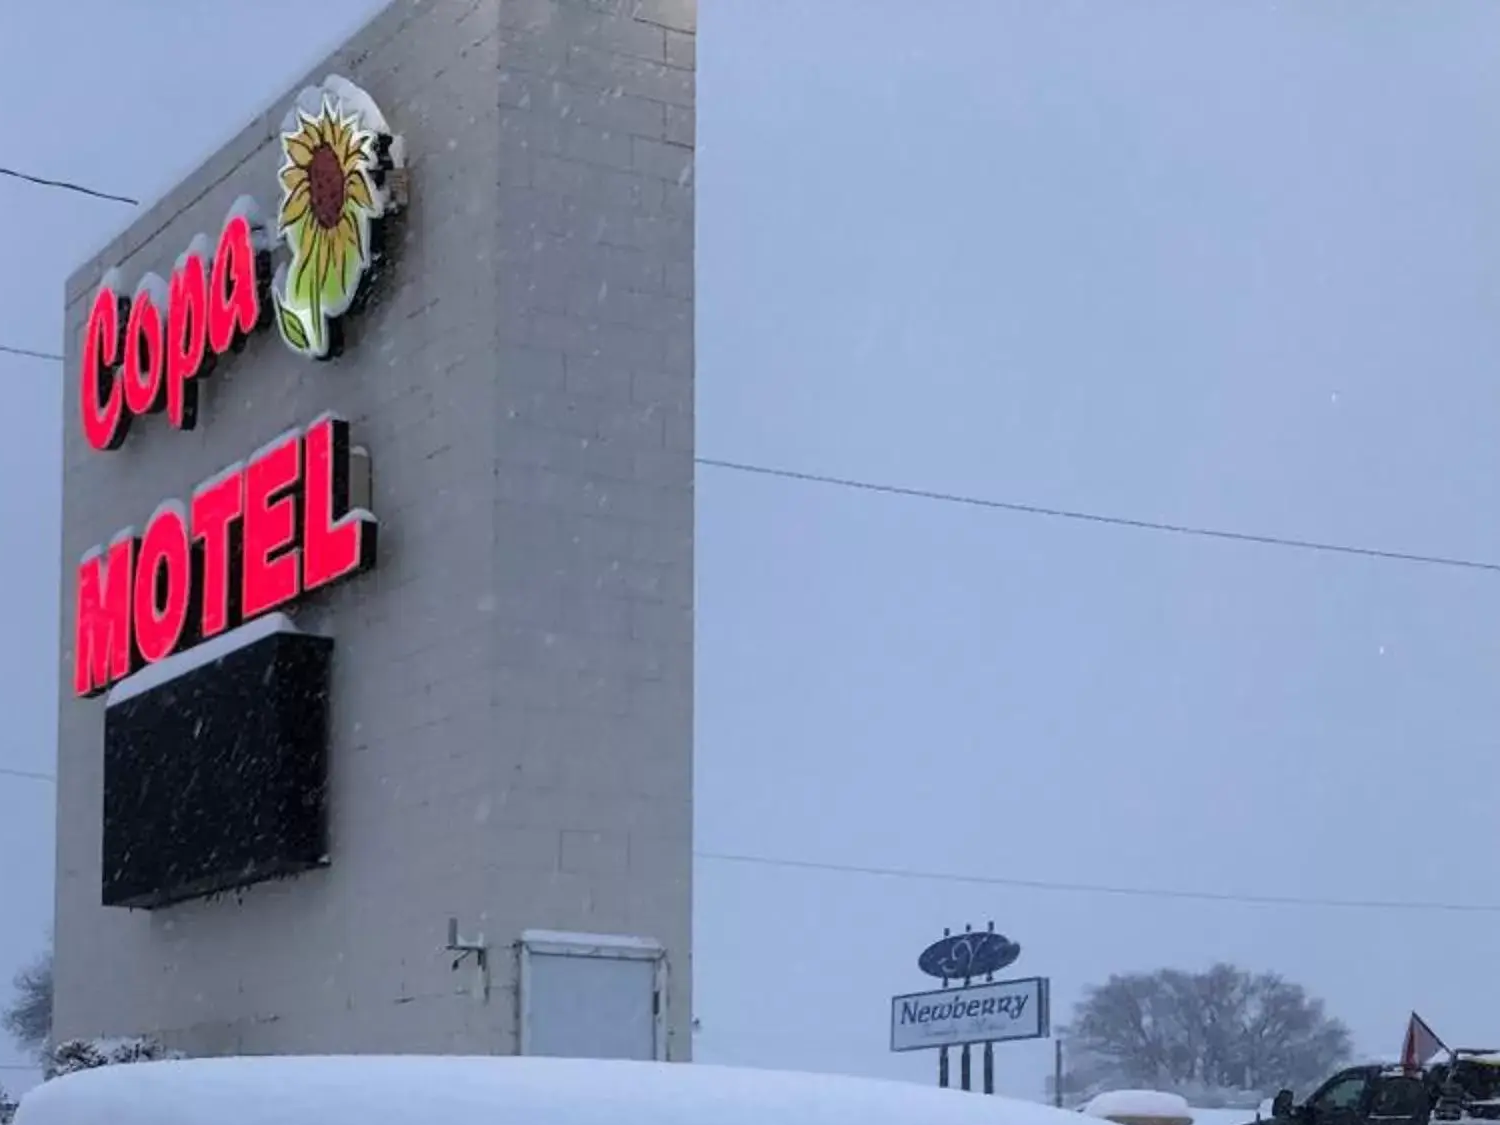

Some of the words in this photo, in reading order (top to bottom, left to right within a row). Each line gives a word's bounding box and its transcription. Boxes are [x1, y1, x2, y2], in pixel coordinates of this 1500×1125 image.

[81, 215, 261, 451] Copa
[74, 416, 366, 697] MOTEL
[901, 994, 1028, 1025] Newberry
